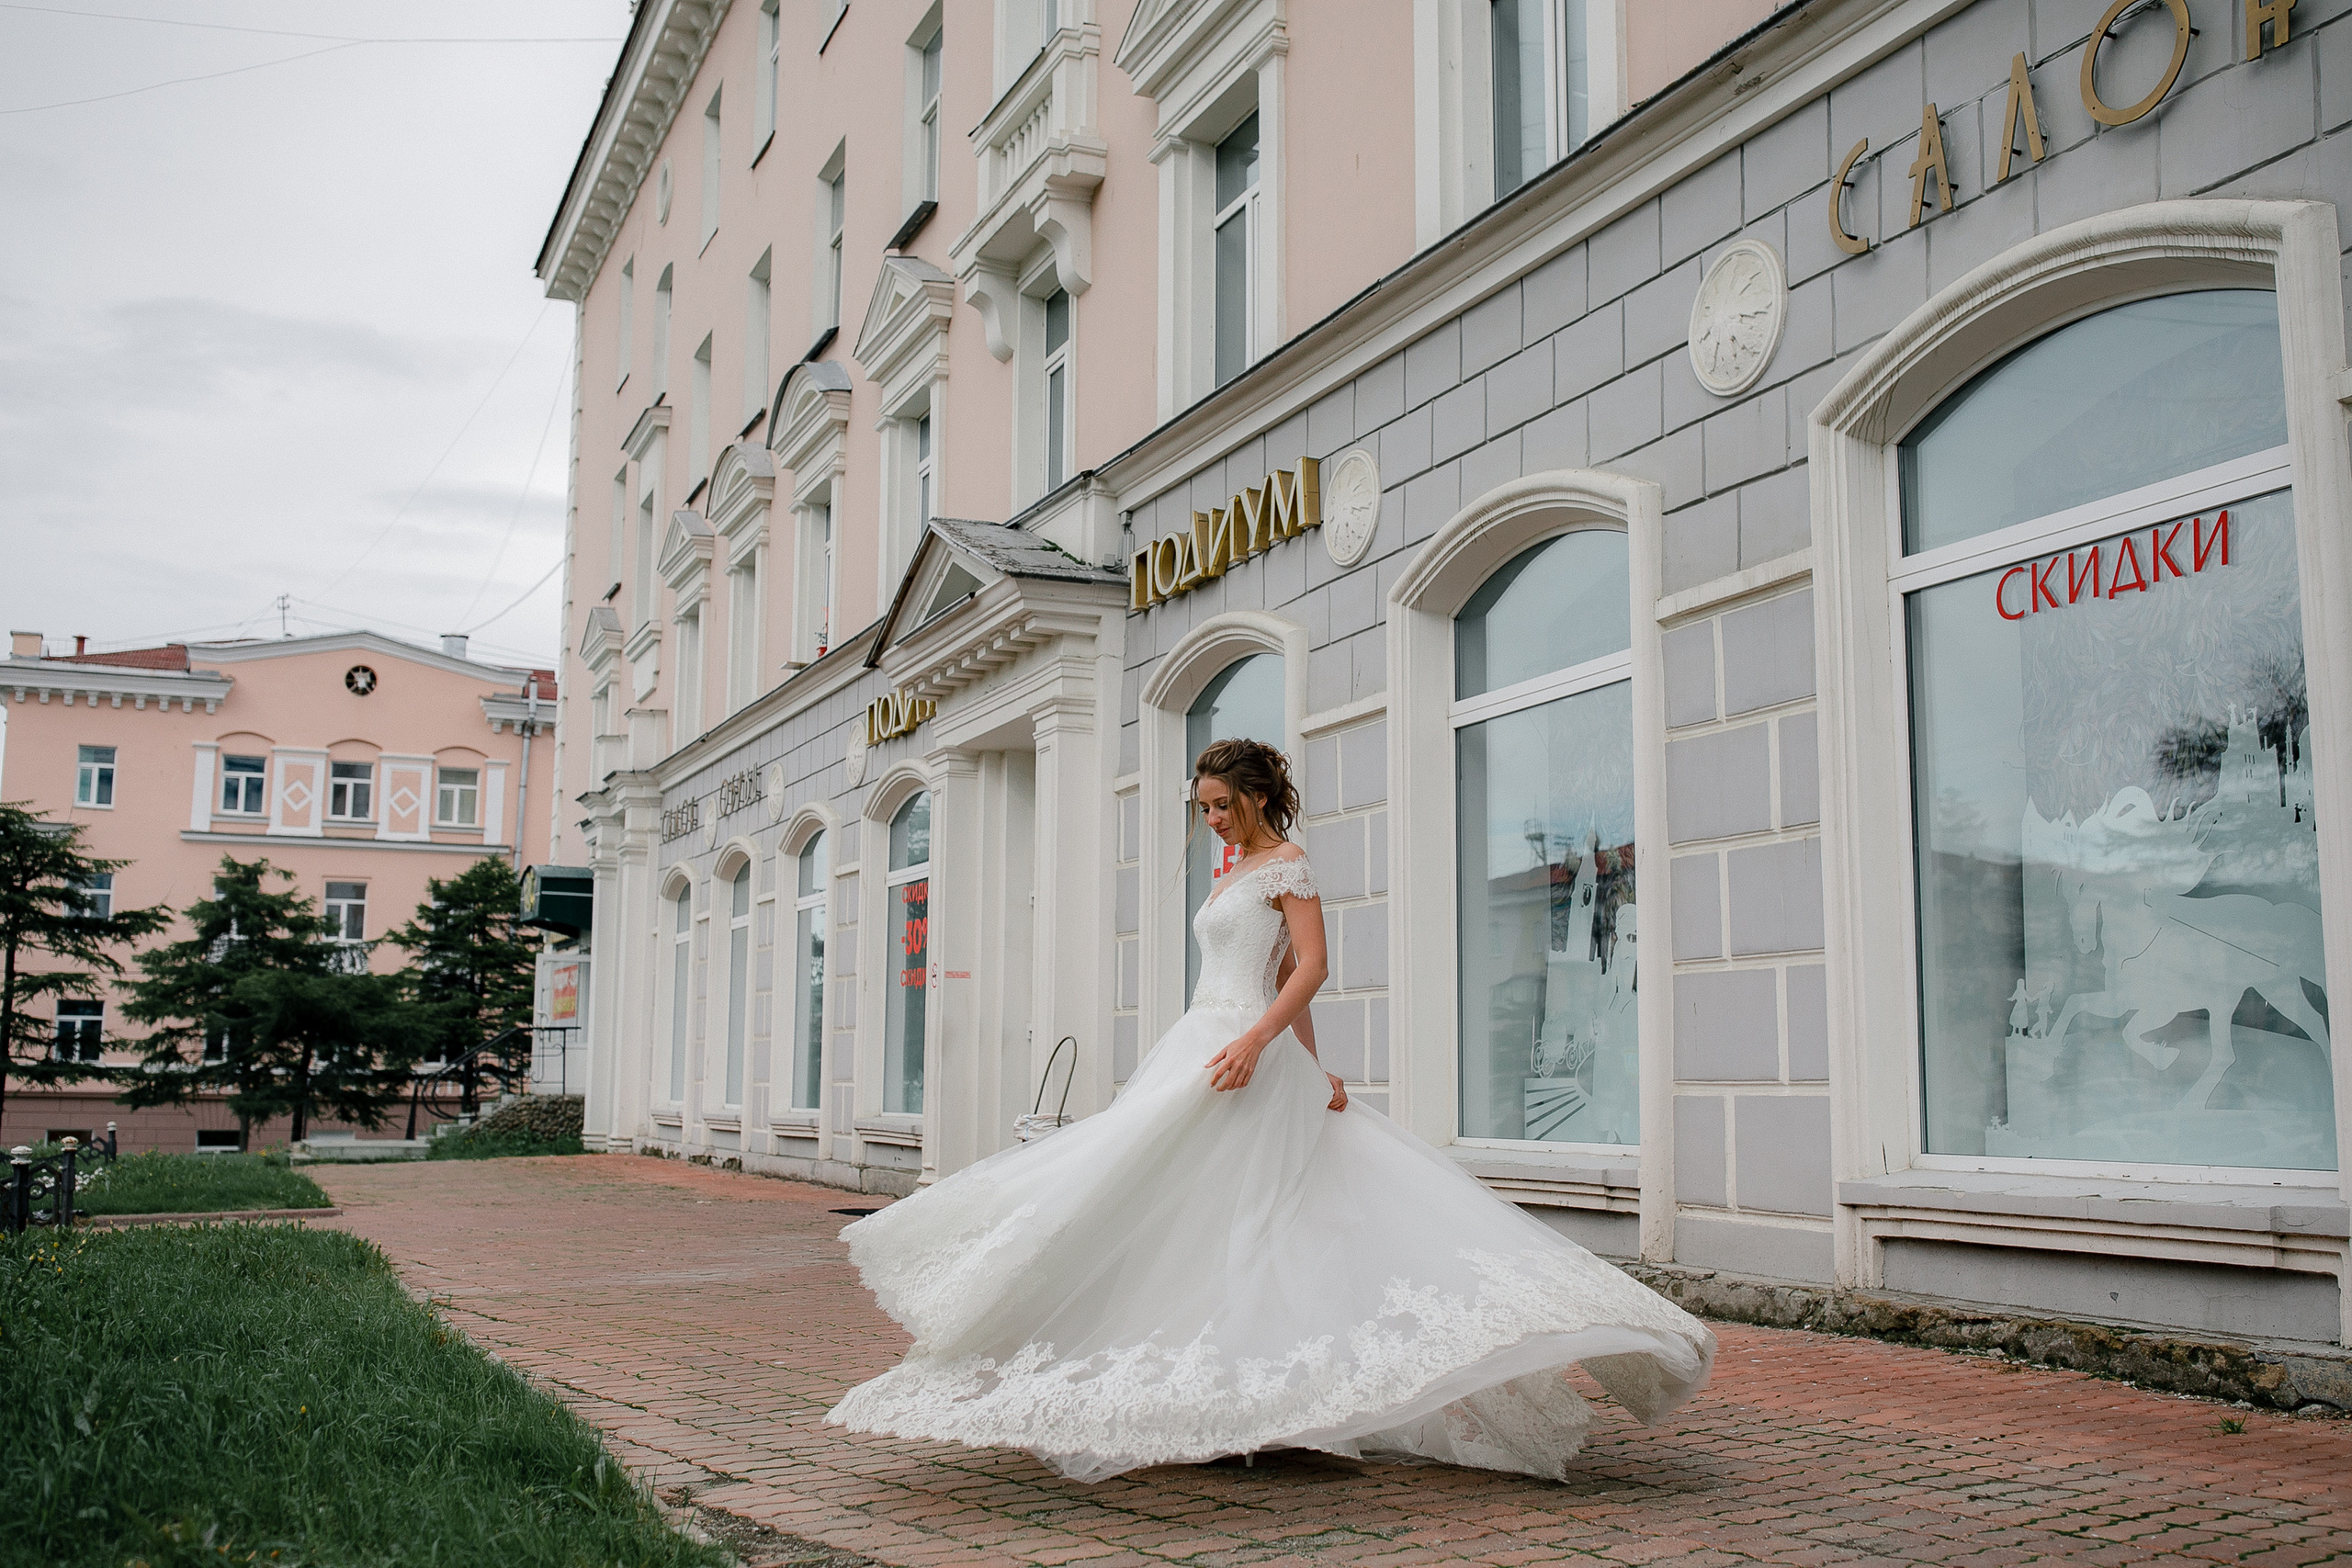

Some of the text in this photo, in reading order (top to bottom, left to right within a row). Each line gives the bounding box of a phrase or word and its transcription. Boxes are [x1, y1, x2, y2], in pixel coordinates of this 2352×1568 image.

[1129, 457, 1321, 612] ПОДИУМ
[1996, 510, 2228, 620] СКИДКИ
[901, 882, 928, 905] СКИДК
